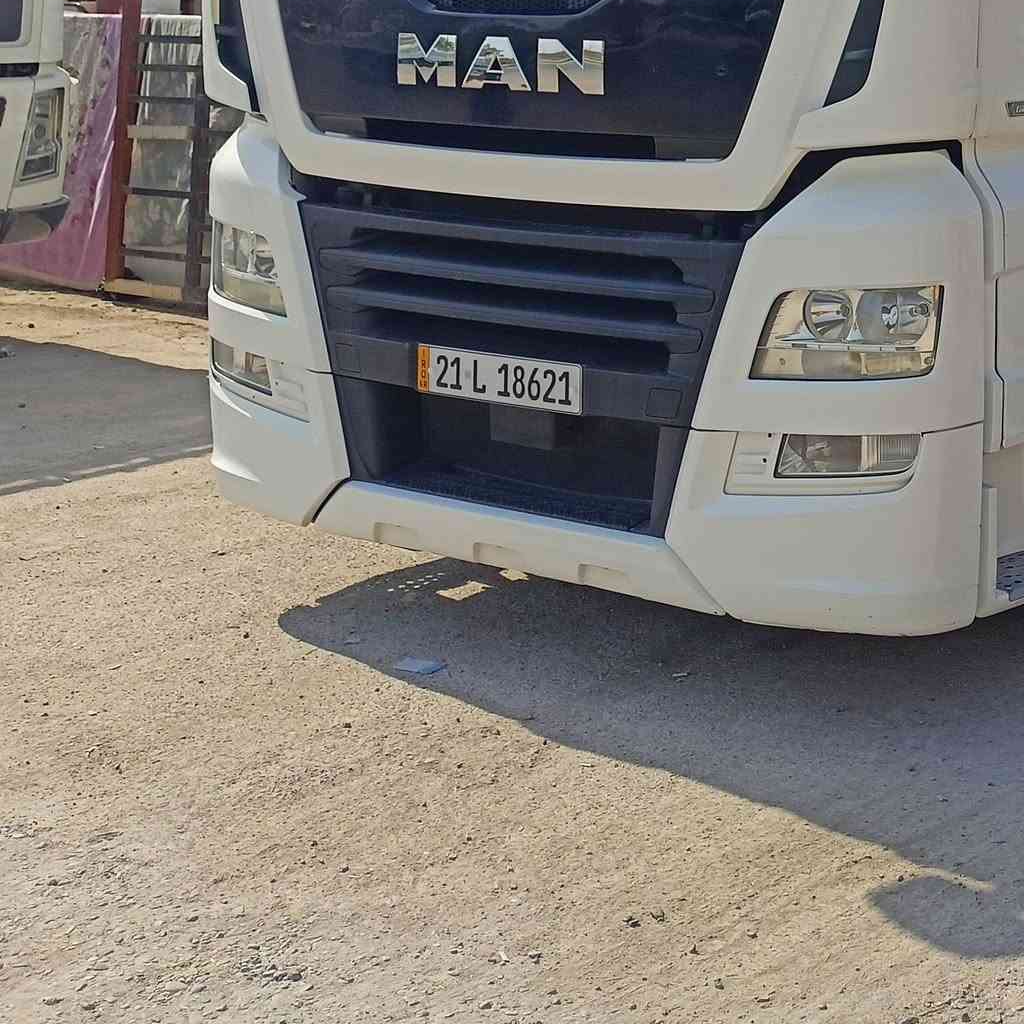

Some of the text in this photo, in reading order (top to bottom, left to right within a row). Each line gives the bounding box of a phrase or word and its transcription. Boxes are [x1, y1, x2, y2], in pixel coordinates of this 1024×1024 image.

[396, 32, 605, 96] MAN
[436, 355, 572, 405] 21 L 18621
